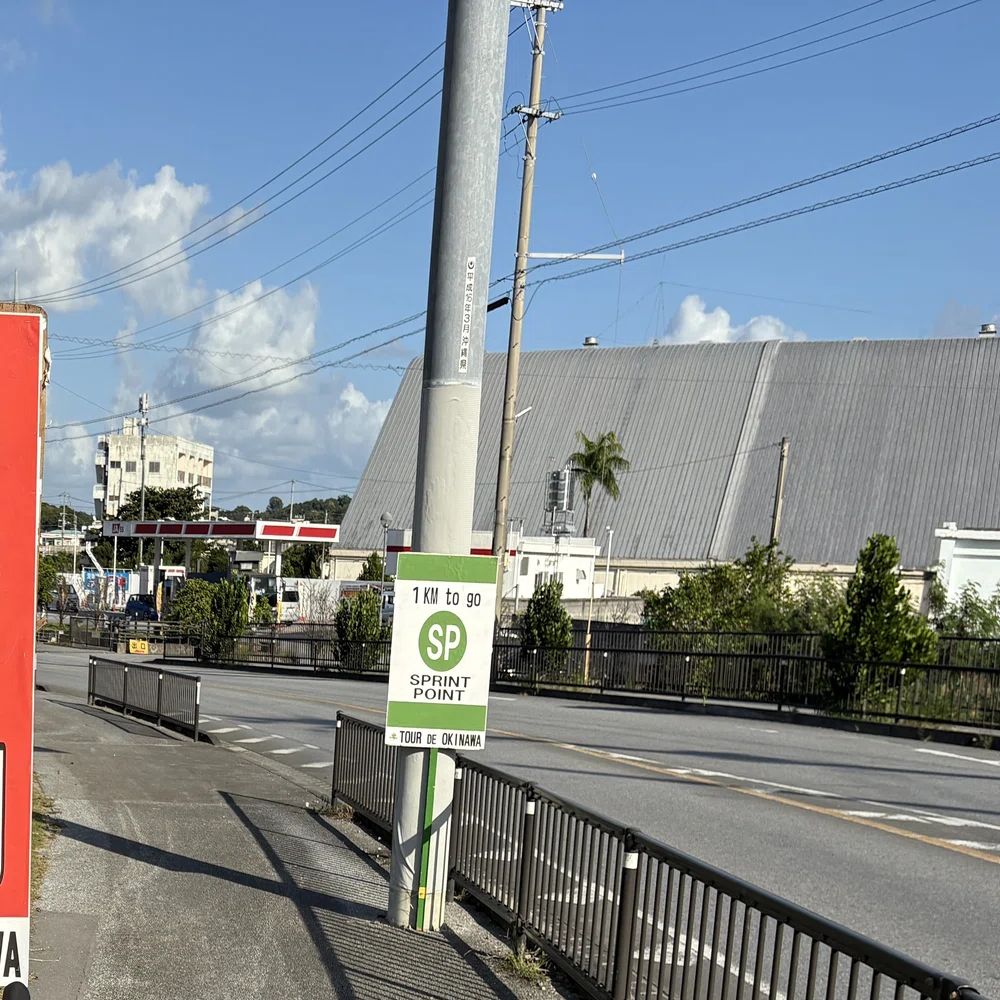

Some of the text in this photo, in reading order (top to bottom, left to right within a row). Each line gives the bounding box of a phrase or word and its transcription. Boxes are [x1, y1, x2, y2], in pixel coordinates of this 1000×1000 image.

[446, 588, 460, 605] to
[466, 592, 481, 607] go
[426, 623, 461, 661] SP
[409, 674, 471, 689] SPRINT
[413, 688, 466, 702] POINT
[399, 730, 422, 745] TOUR
[426, 734, 437, 745] DE
[442, 733, 482, 748] OKINAWA
